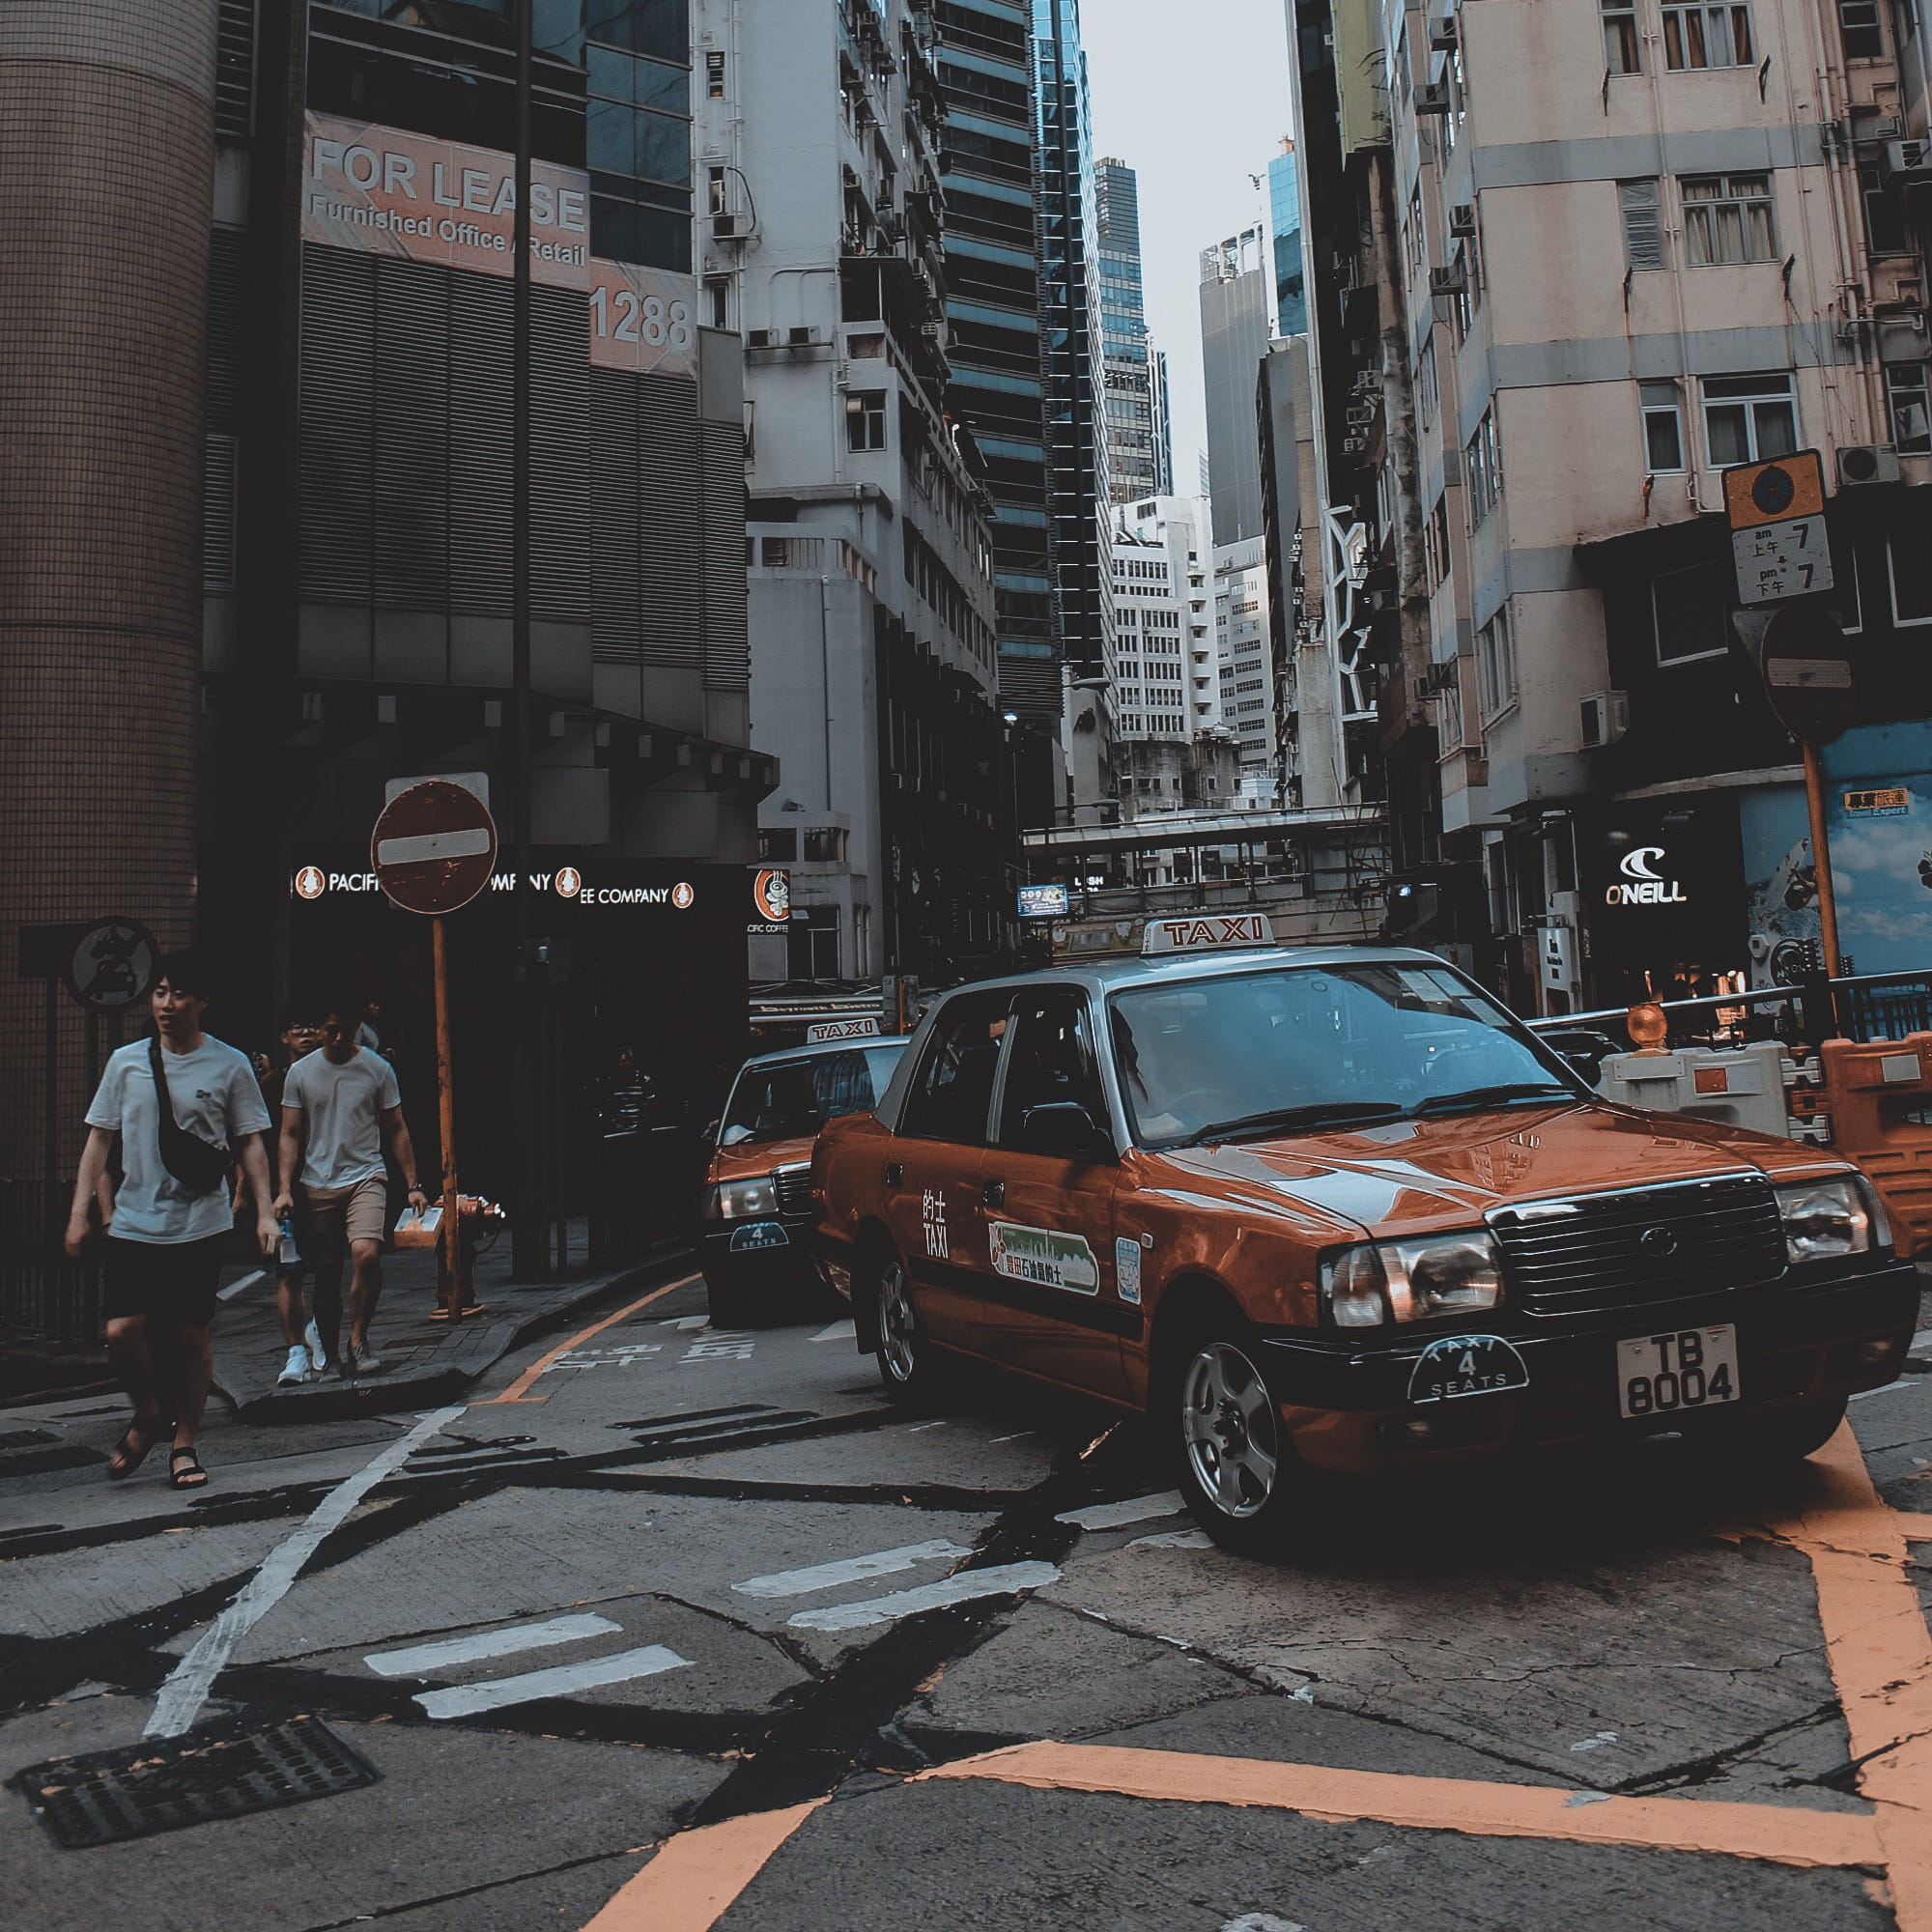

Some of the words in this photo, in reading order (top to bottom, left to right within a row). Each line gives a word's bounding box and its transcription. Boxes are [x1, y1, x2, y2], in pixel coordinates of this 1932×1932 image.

[313, 138, 416, 199] FOR
[432, 162, 585, 233] LEASE
[310, 193, 432, 238] Furnished
[439, 219, 505, 252] Office
[528, 236, 585, 266] Retail
[589, 286, 694, 352] 1288
[1754, 529, 1773, 540] am
[1792, 523, 1809, 549] 7
[1752, 541, 1779, 558] 上午
[1756, 581, 1784, 596] 下午
[1759, 569, 1777, 582] pm
[1797, 563, 1814, 588] 7
[598, 889, 669, 903] COMPANY
[1163, 916, 1264, 947] TAXI
[812, 1020, 873, 1038] TAXI
[923, 1189, 946, 1223] 的士
[752, 1228, 763, 1238] 4
[923, 1223, 949, 1259] TAXI
[1427, 1337, 1494, 1362] TAXI
[1650, 1331, 1703, 1373] TB
[1459, 1350, 1477, 1376] 4
[1430, 1374, 1507, 1397] SEATS
[1628, 1363, 1733, 1415] 8004
